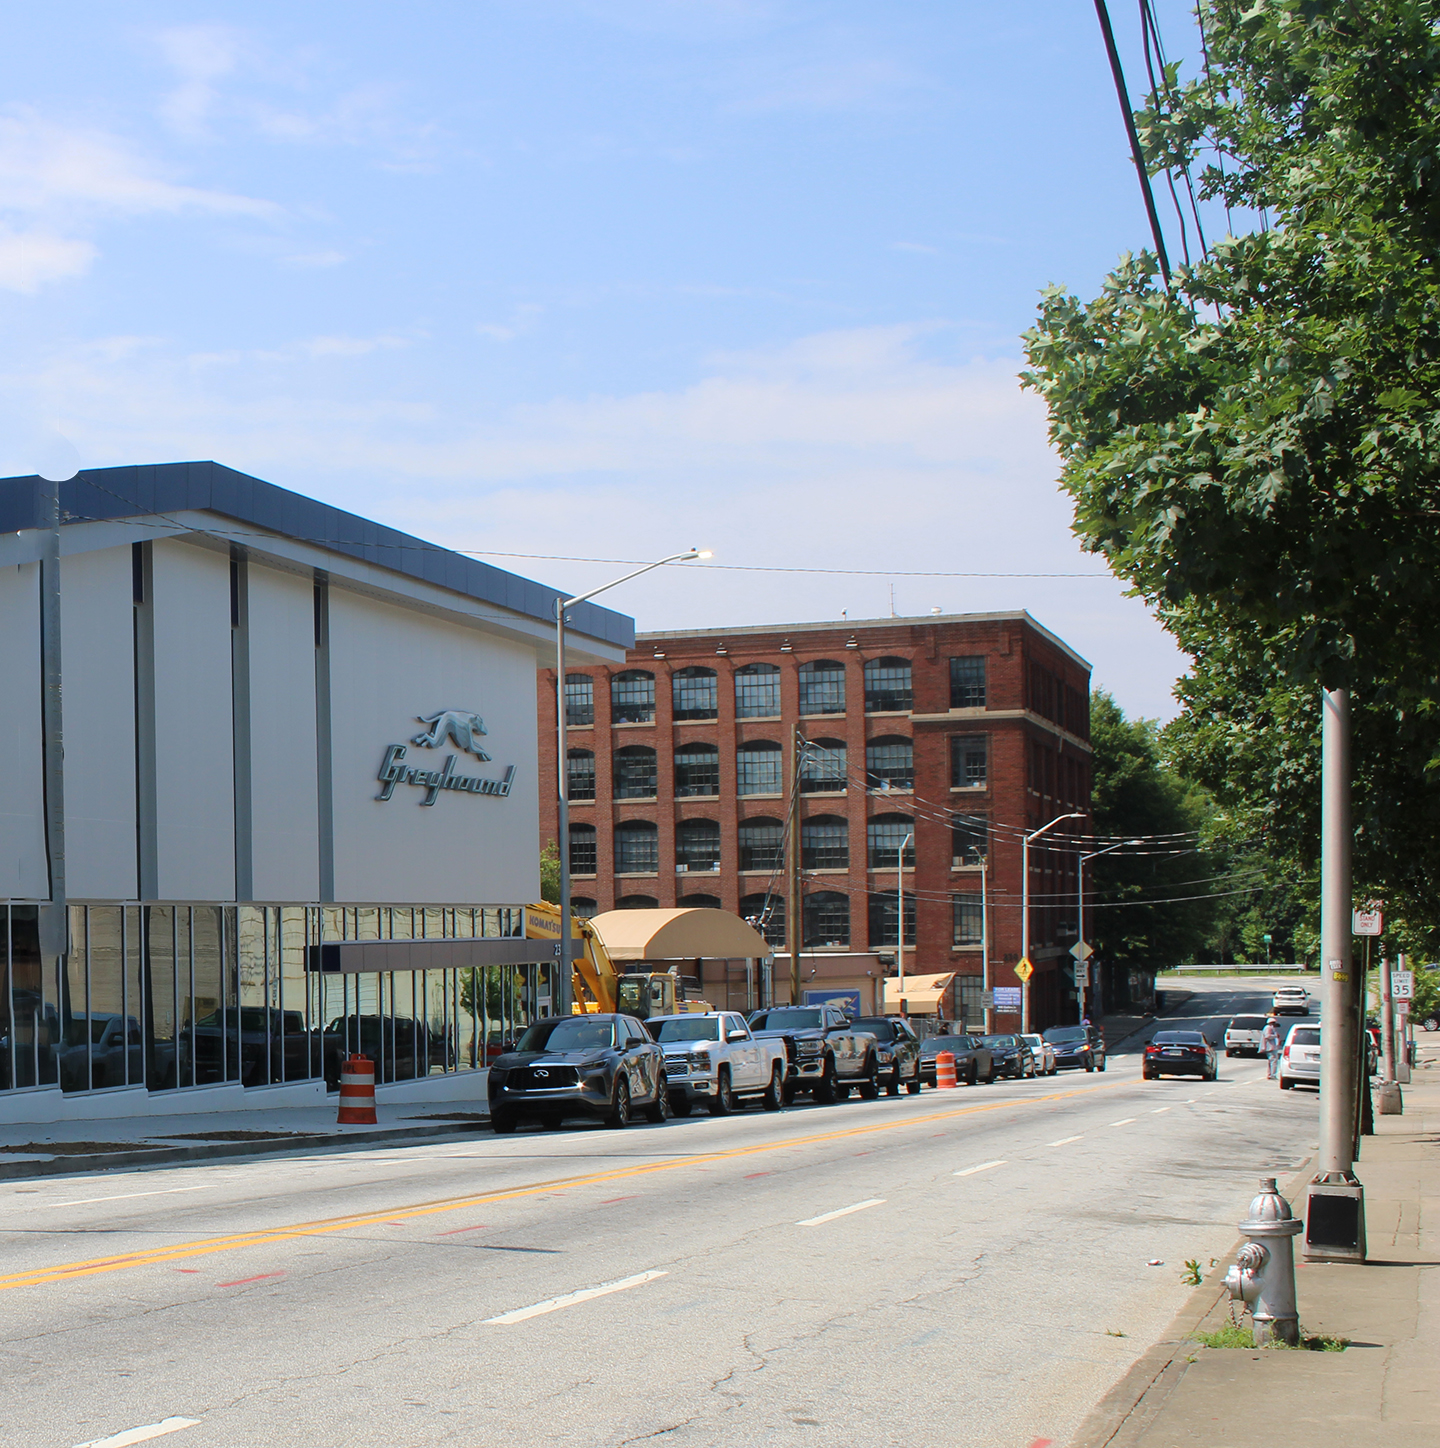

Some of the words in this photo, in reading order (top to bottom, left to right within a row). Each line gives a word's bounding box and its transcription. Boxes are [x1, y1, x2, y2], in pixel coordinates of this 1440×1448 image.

[374, 744, 517, 806] Greyhound
[529, 914, 561, 935] KOMATSU
[1393, 985, 1409, 995] 35
